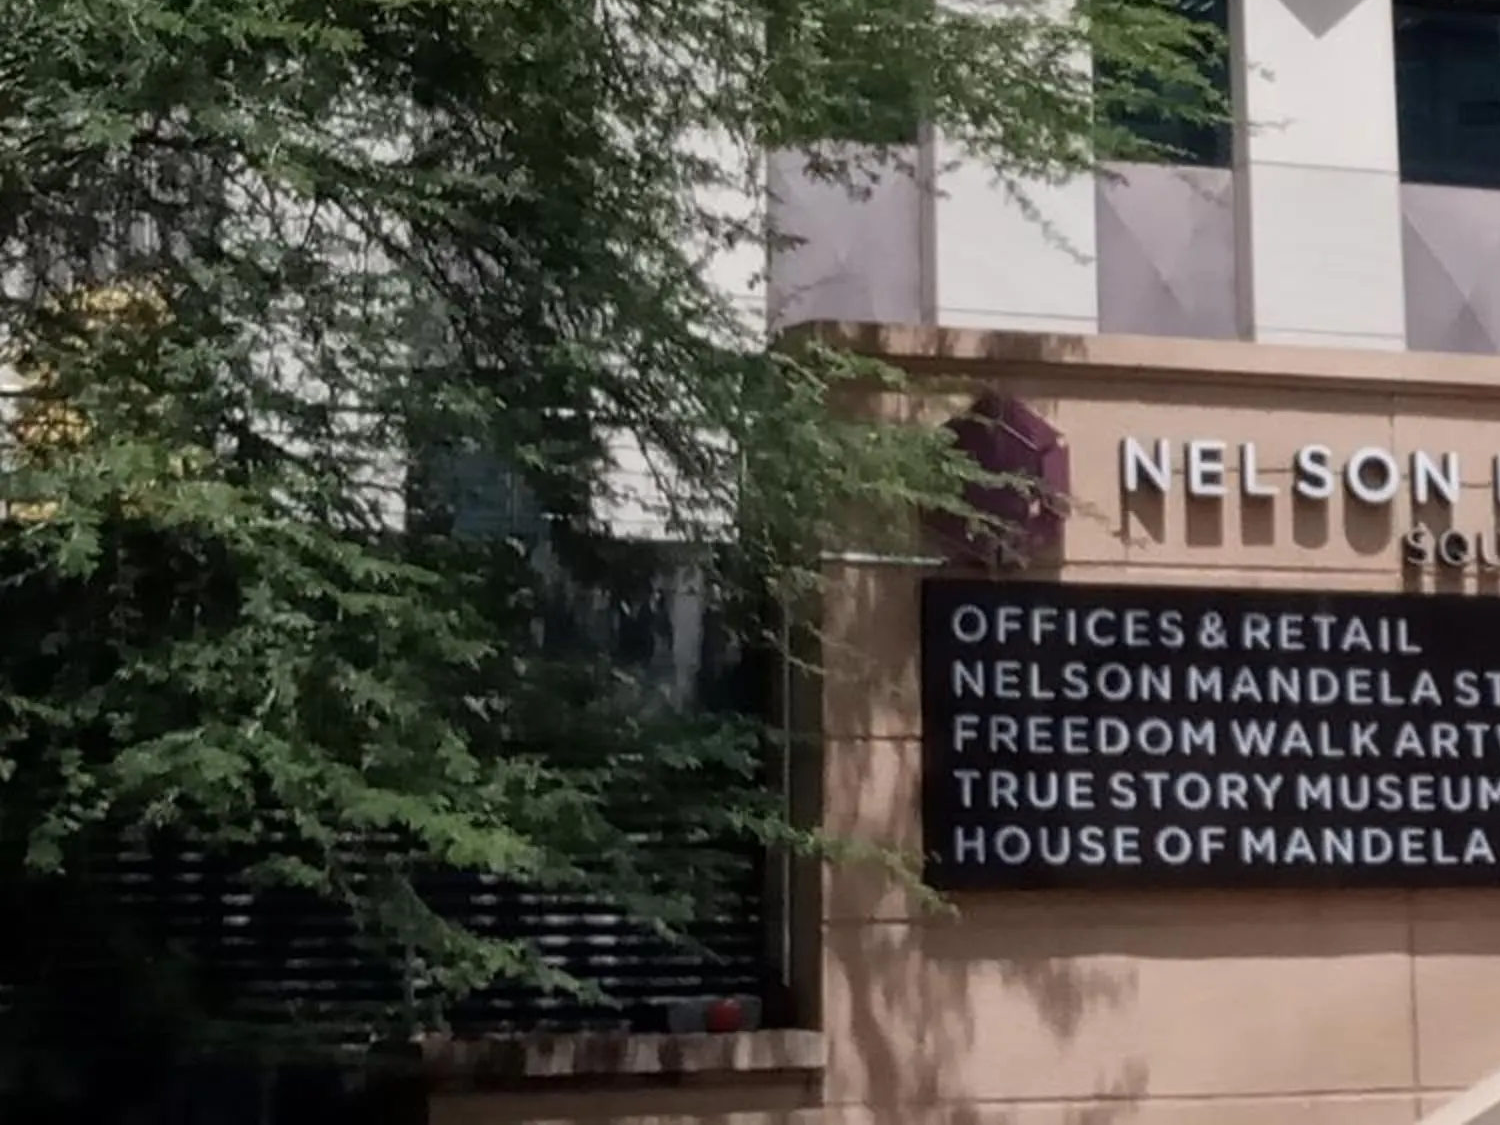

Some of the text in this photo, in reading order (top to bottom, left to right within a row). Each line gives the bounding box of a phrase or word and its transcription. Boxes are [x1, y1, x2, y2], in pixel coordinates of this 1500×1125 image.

[1119, 436, 1461, 505] NELSON
[952, 604, 1422, 654] OFFICES & RETAIL
[952, 660, 1172, 702] NELSON
[1187, 665, 1443, 707] MANDELA
[953, 714, 1217, 757] FREEDOM
[1230, 718, 1382, 758] WALK
[952, 769, 1096, 811] TRUE
[1108, 771, 1284, 811] STORY
[954, 824, 1142, 865] HOUSE
[1155, 825, 1227, 865] OF
[1240, 825, 1496, 865] MANDELA
